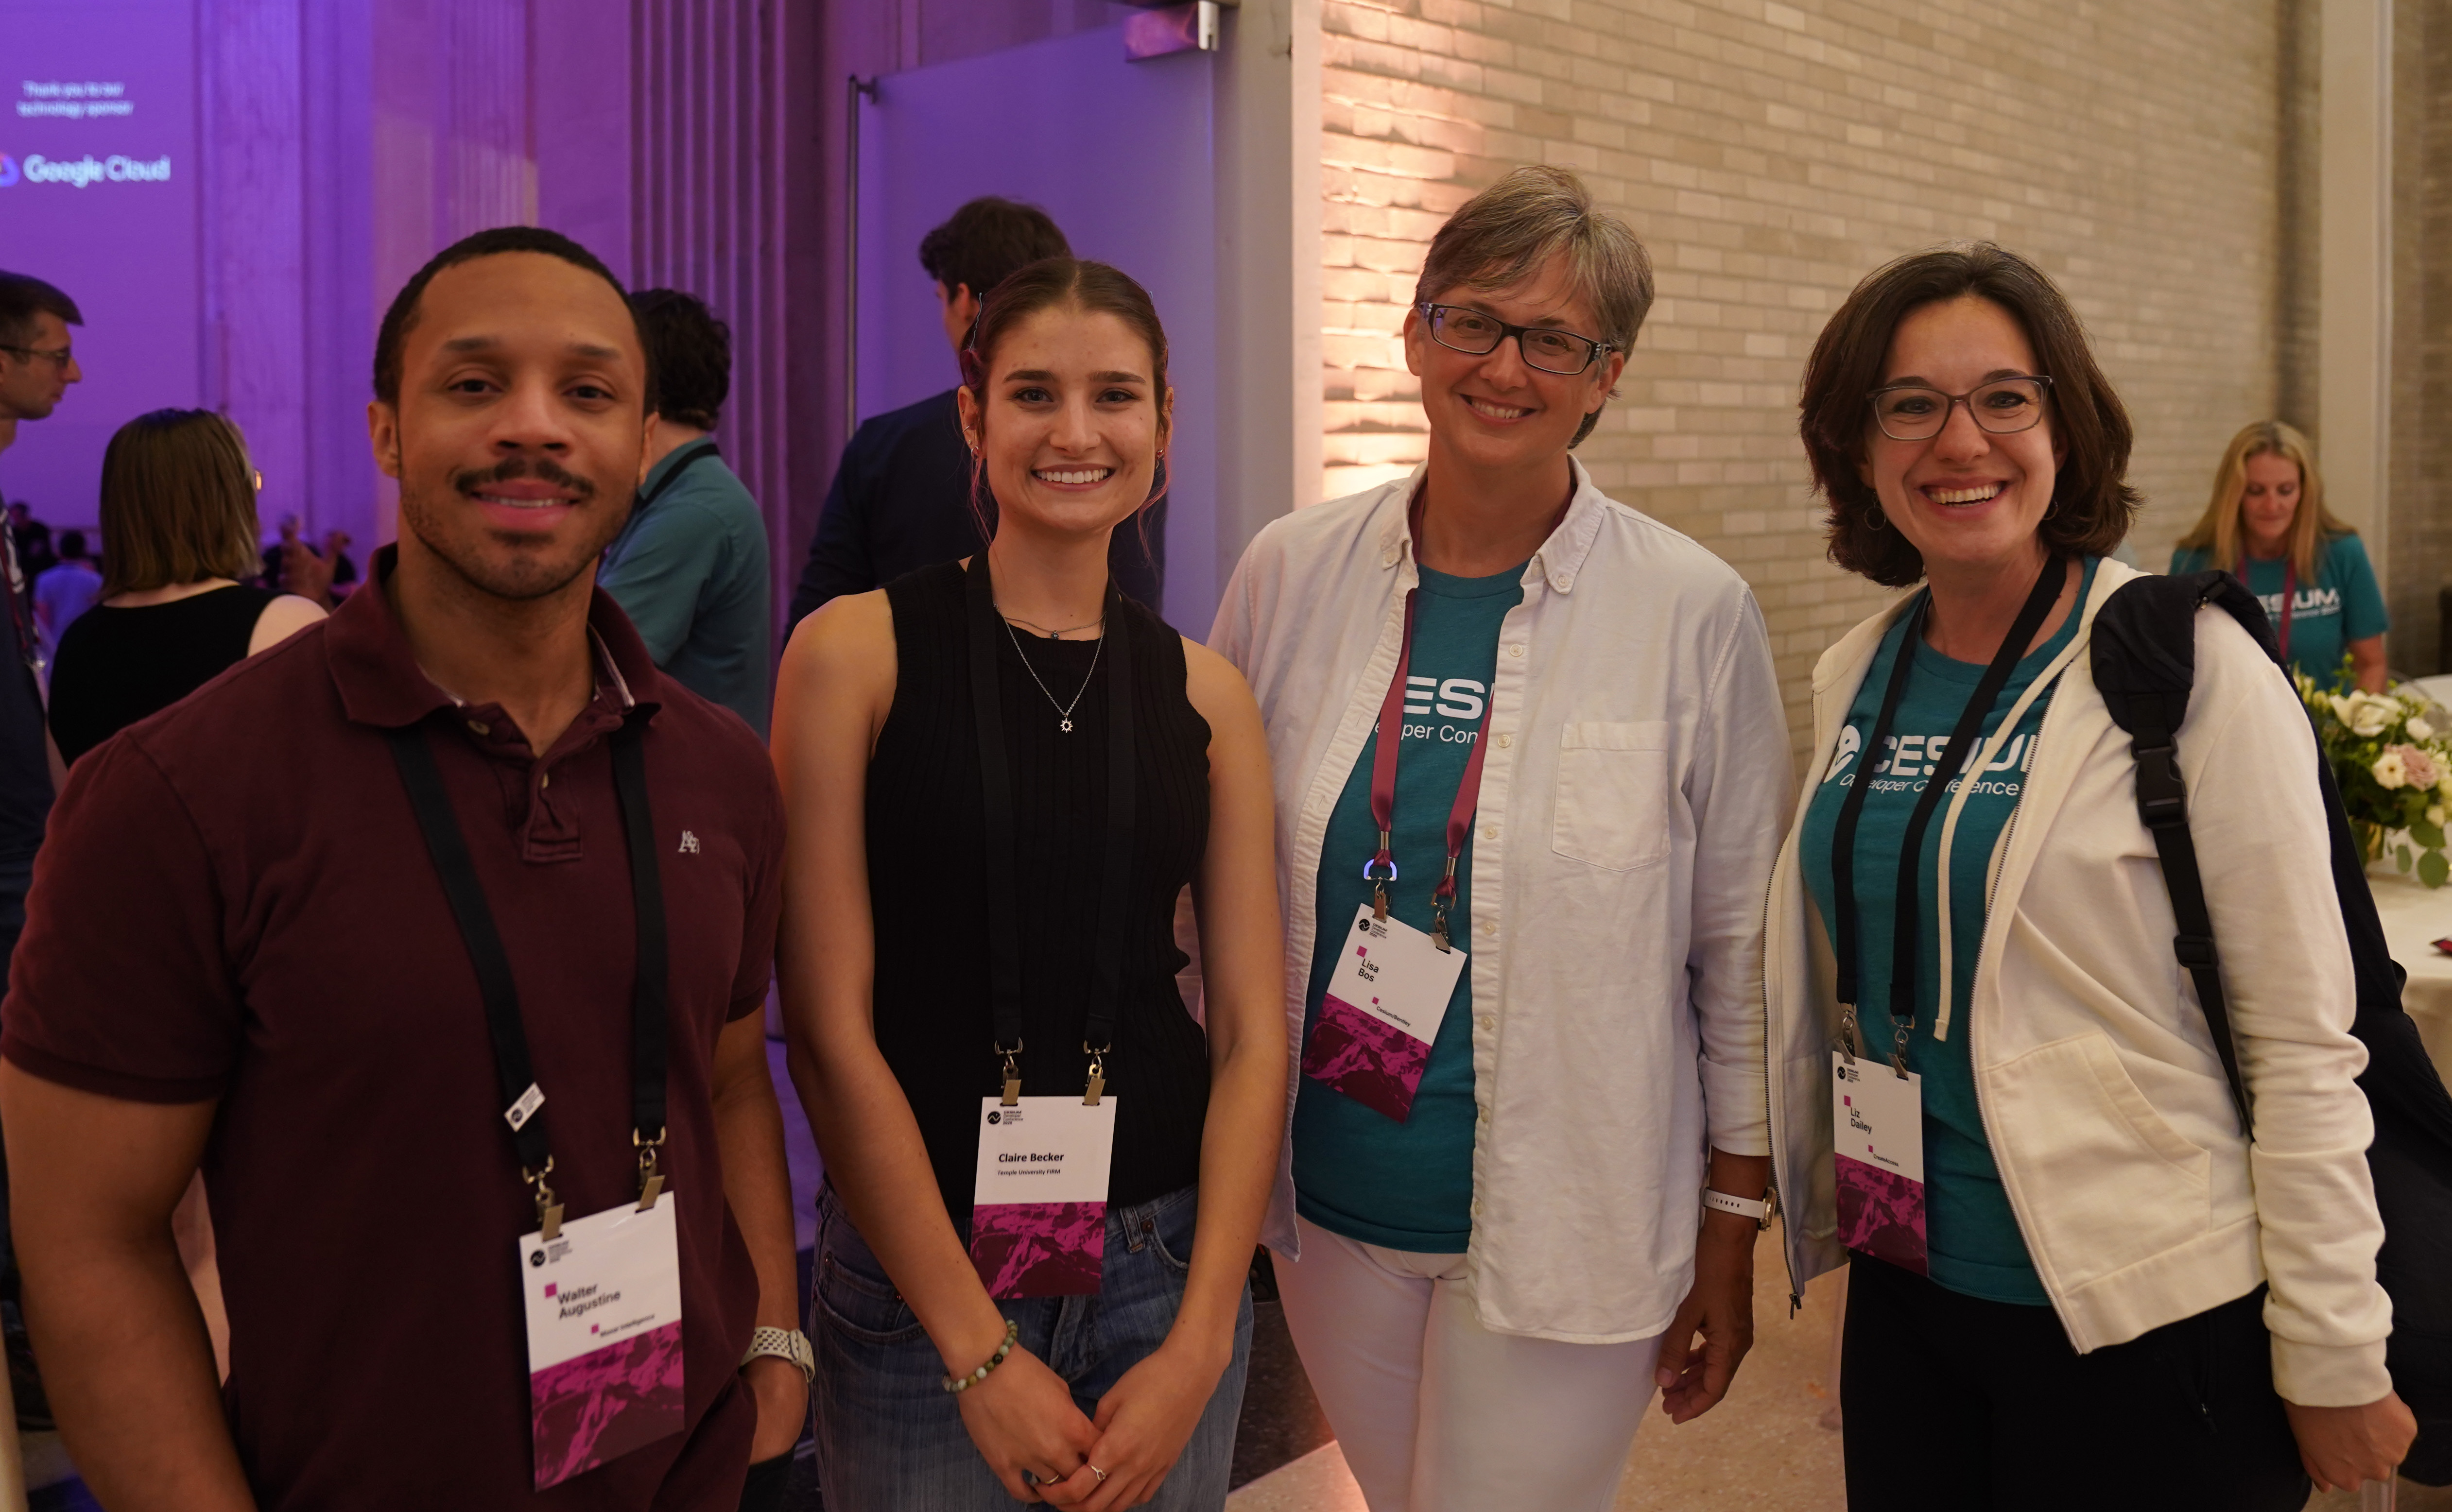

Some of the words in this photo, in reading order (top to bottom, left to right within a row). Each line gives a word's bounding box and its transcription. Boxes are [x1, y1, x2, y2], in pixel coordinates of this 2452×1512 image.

[23, 154, 105, 189] Google
[105, 155, 171, 182] Cloud
[1440, 725, 1478, 744] Con
[1362, 958, 1379, 973] Lisa
[1358, 968, 1375, 982] Bos
[1376, 1006, 1411, 1027] Cesium/Bentley
[1850, 1107, 1861, 1118] Liz
[1850, 1118, 1872, 1134] Dailey
[999, 1153, 1027, 1163] Claire
[1030, 1152, 1064, 1162] Becker
[558, 1284, 598, 1305] Walter
[559, 1290, 621, 1320] Augustine
